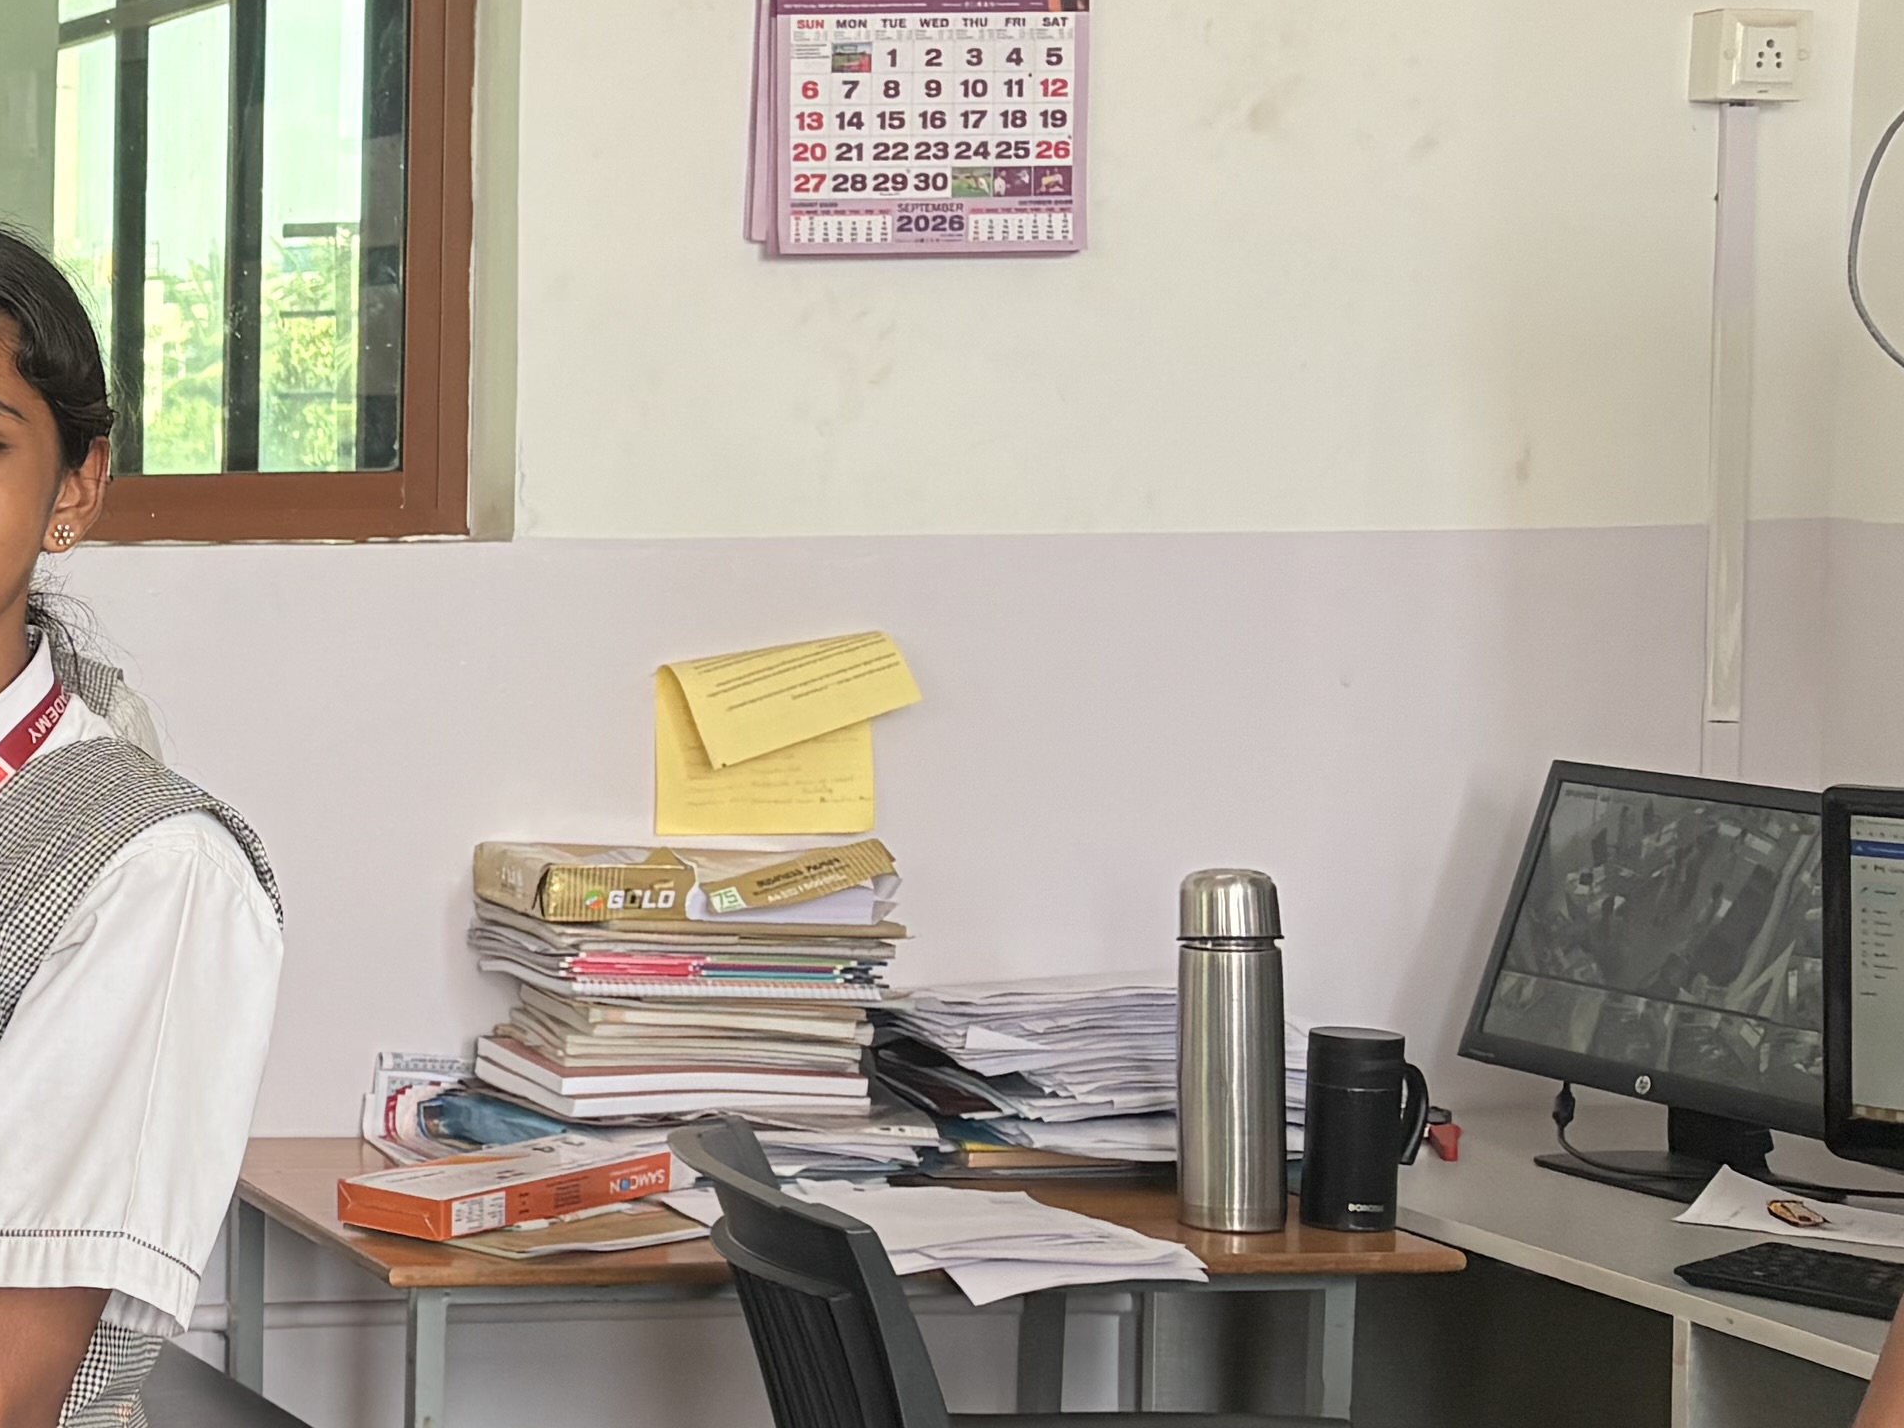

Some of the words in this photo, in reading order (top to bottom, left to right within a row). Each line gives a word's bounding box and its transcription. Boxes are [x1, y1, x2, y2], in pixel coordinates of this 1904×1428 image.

[797, 20, 824, 29] SUN
[836, 20, 867, 29] MON
[881, 19, 907, 28] TUE
[919, 19, 949, 28] WED
[962, 18, 988, 28] THU
[1004, 18, 1026, 27] FRI
[1042, 17, 1068, 27] SAT
[887, 48, 897, 67] 1
[925, 48, 942, 67] 2
[965, 48, 983, 67] 3
[1005, 47, 1024, 67] 4
[1045, 47, 1063, 66] 5
[801, 80, 819, 100] 6
[842, 80, 859, 99] 7
[883, 80, 900, 99] 8
[924, 79, 942, 98] 9
[960, 79, 988, 98] 10
[1004, 79, 1024, 97] 11
[1040, 78, 1069, 97] 12
[795, 112, 824, 131] 13
[835, 111, 864, 130] 14
[876, 111, 906, 130] 15
[918, 110, 947, 129] 16
[960, 110, 988, 129] 17
[1000, 110, 1027, 128] 18
[1040, 109, 1068, 128] 19
[792, 143, 827, 161] 20
[835, 143, 864, 161] 21
[873, 142, 909, 161] 22
[914, 142, 949, 161] 23
[954, 141, 990, 160] 24
[995, 141, 1030, 160] 25
[1035, 141, 1071, 159] 26
[794, 174, 827, 193] 27
[831, 173, 867, 192] 28
[872, 173, 908, 191] 29
[913, 173, 948, 191] 30
[897, 203, 964, 213] SEPTEMBER
[896, 215, 965, 232] 2026
[712, 892, 739, 906] 75
